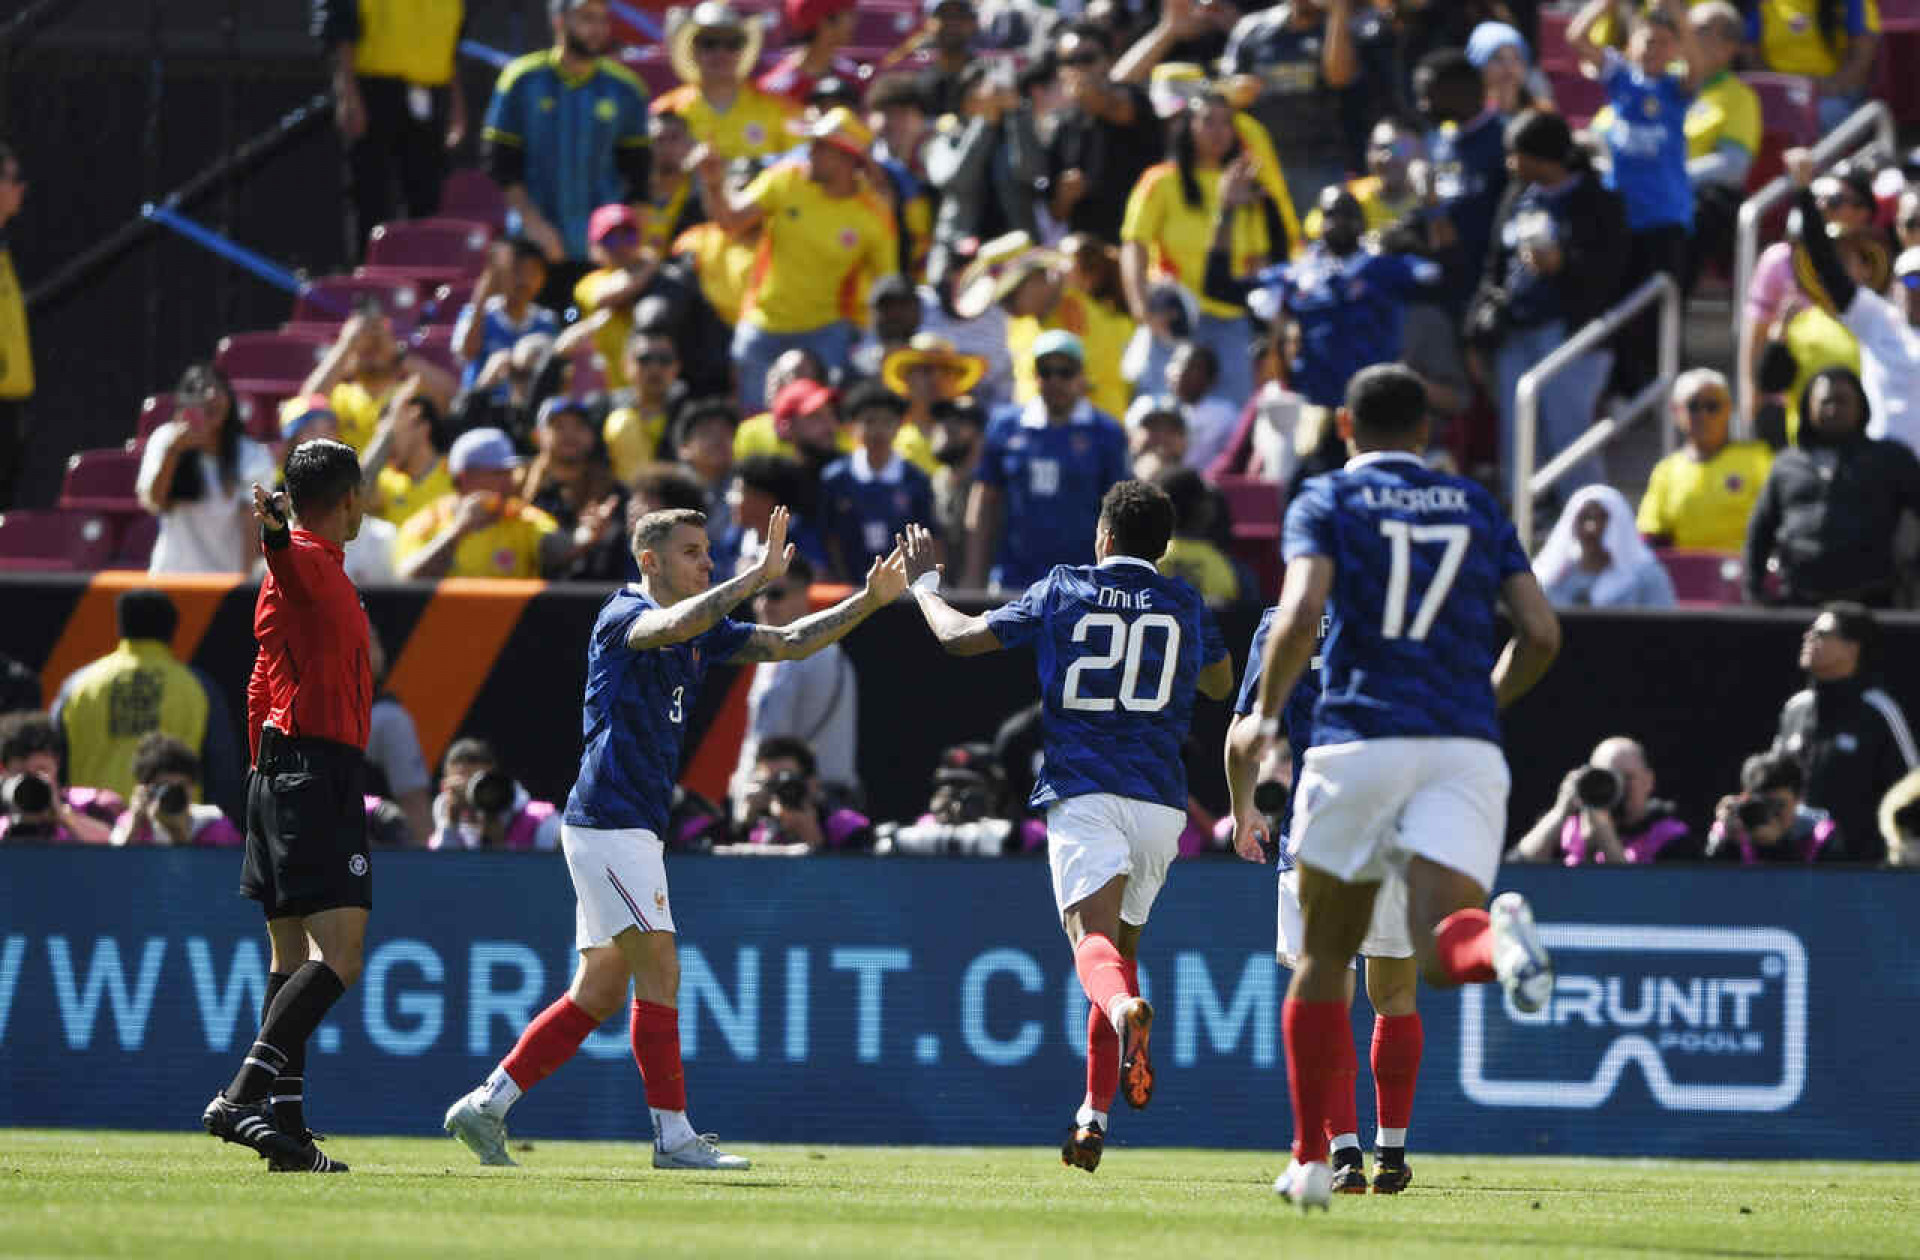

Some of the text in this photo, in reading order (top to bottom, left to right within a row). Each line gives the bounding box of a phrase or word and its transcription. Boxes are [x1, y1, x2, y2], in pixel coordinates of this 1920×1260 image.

[1380, 520, 1471, 642] 17
[669, 686, 685, 724] 3
[1063, 613, 1180, 712] 20
